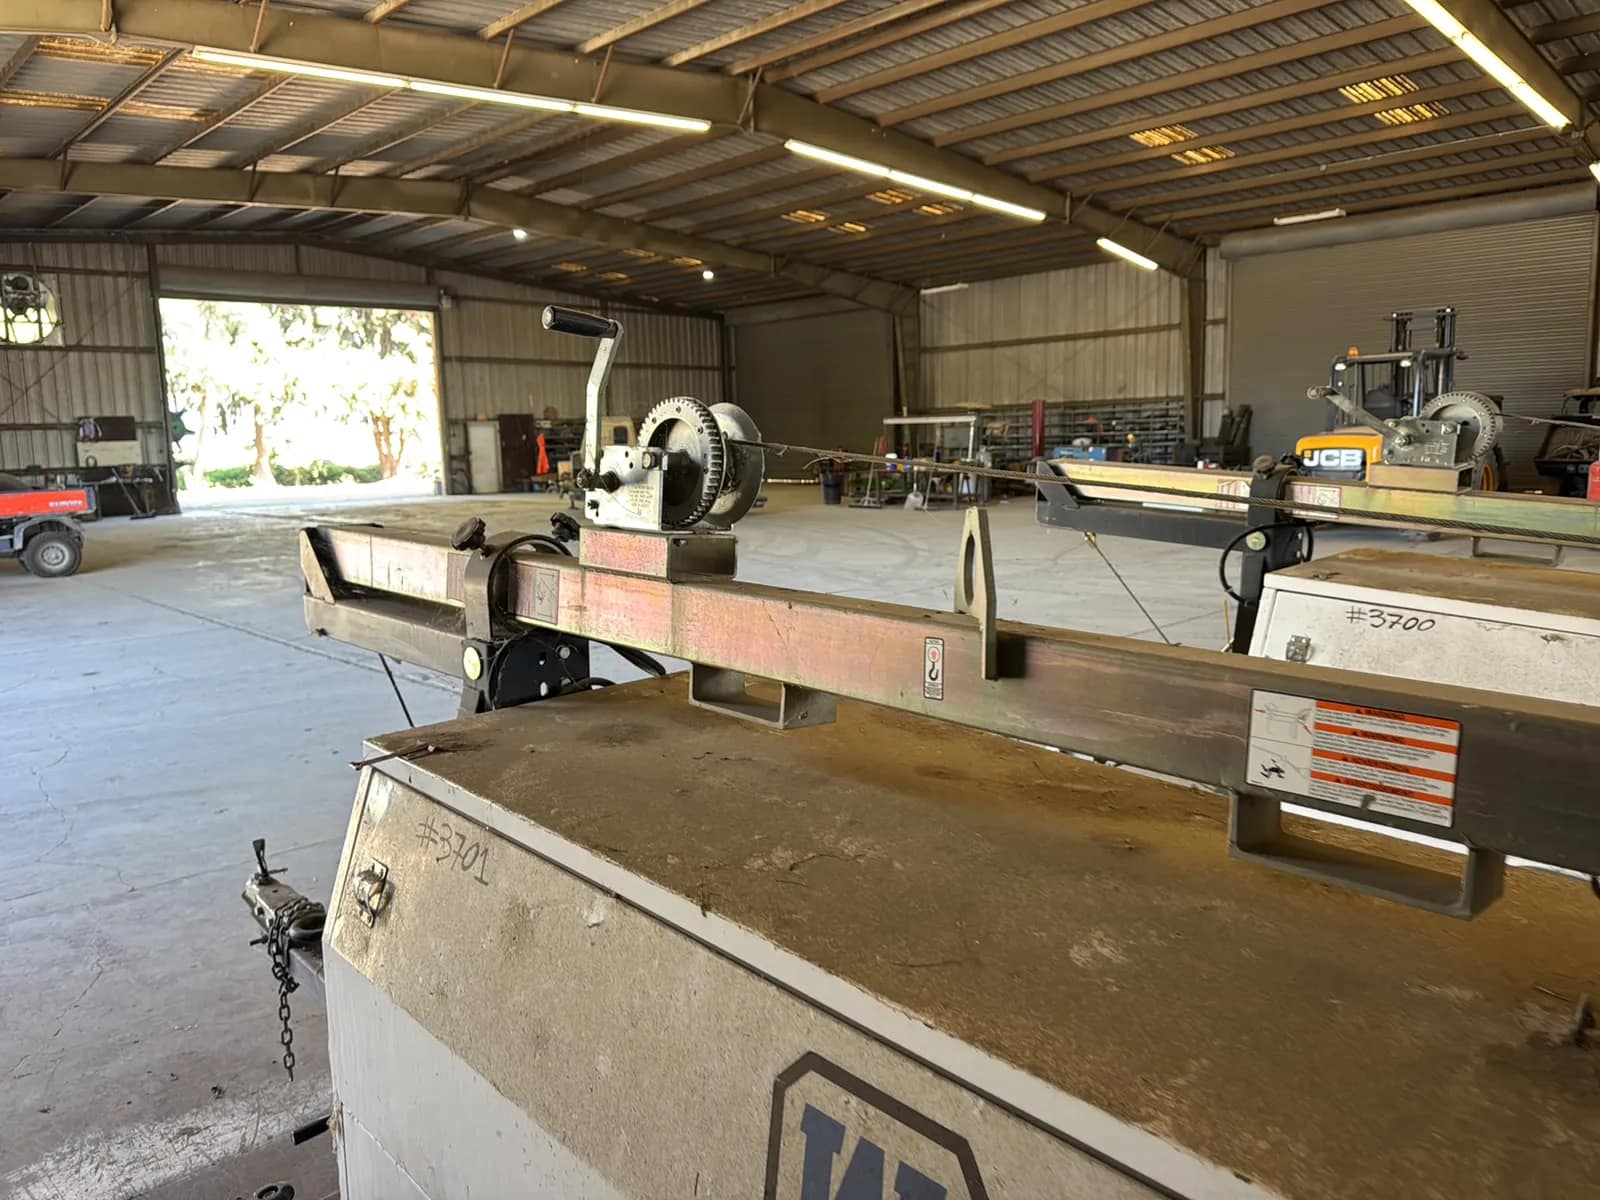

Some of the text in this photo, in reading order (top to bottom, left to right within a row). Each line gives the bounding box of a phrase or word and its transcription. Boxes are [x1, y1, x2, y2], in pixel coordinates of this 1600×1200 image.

[1303, 449, 1363, 468] JCB
[1345, 606, 1436, 631] #3700
[416, 816, 489, 886] #3701
